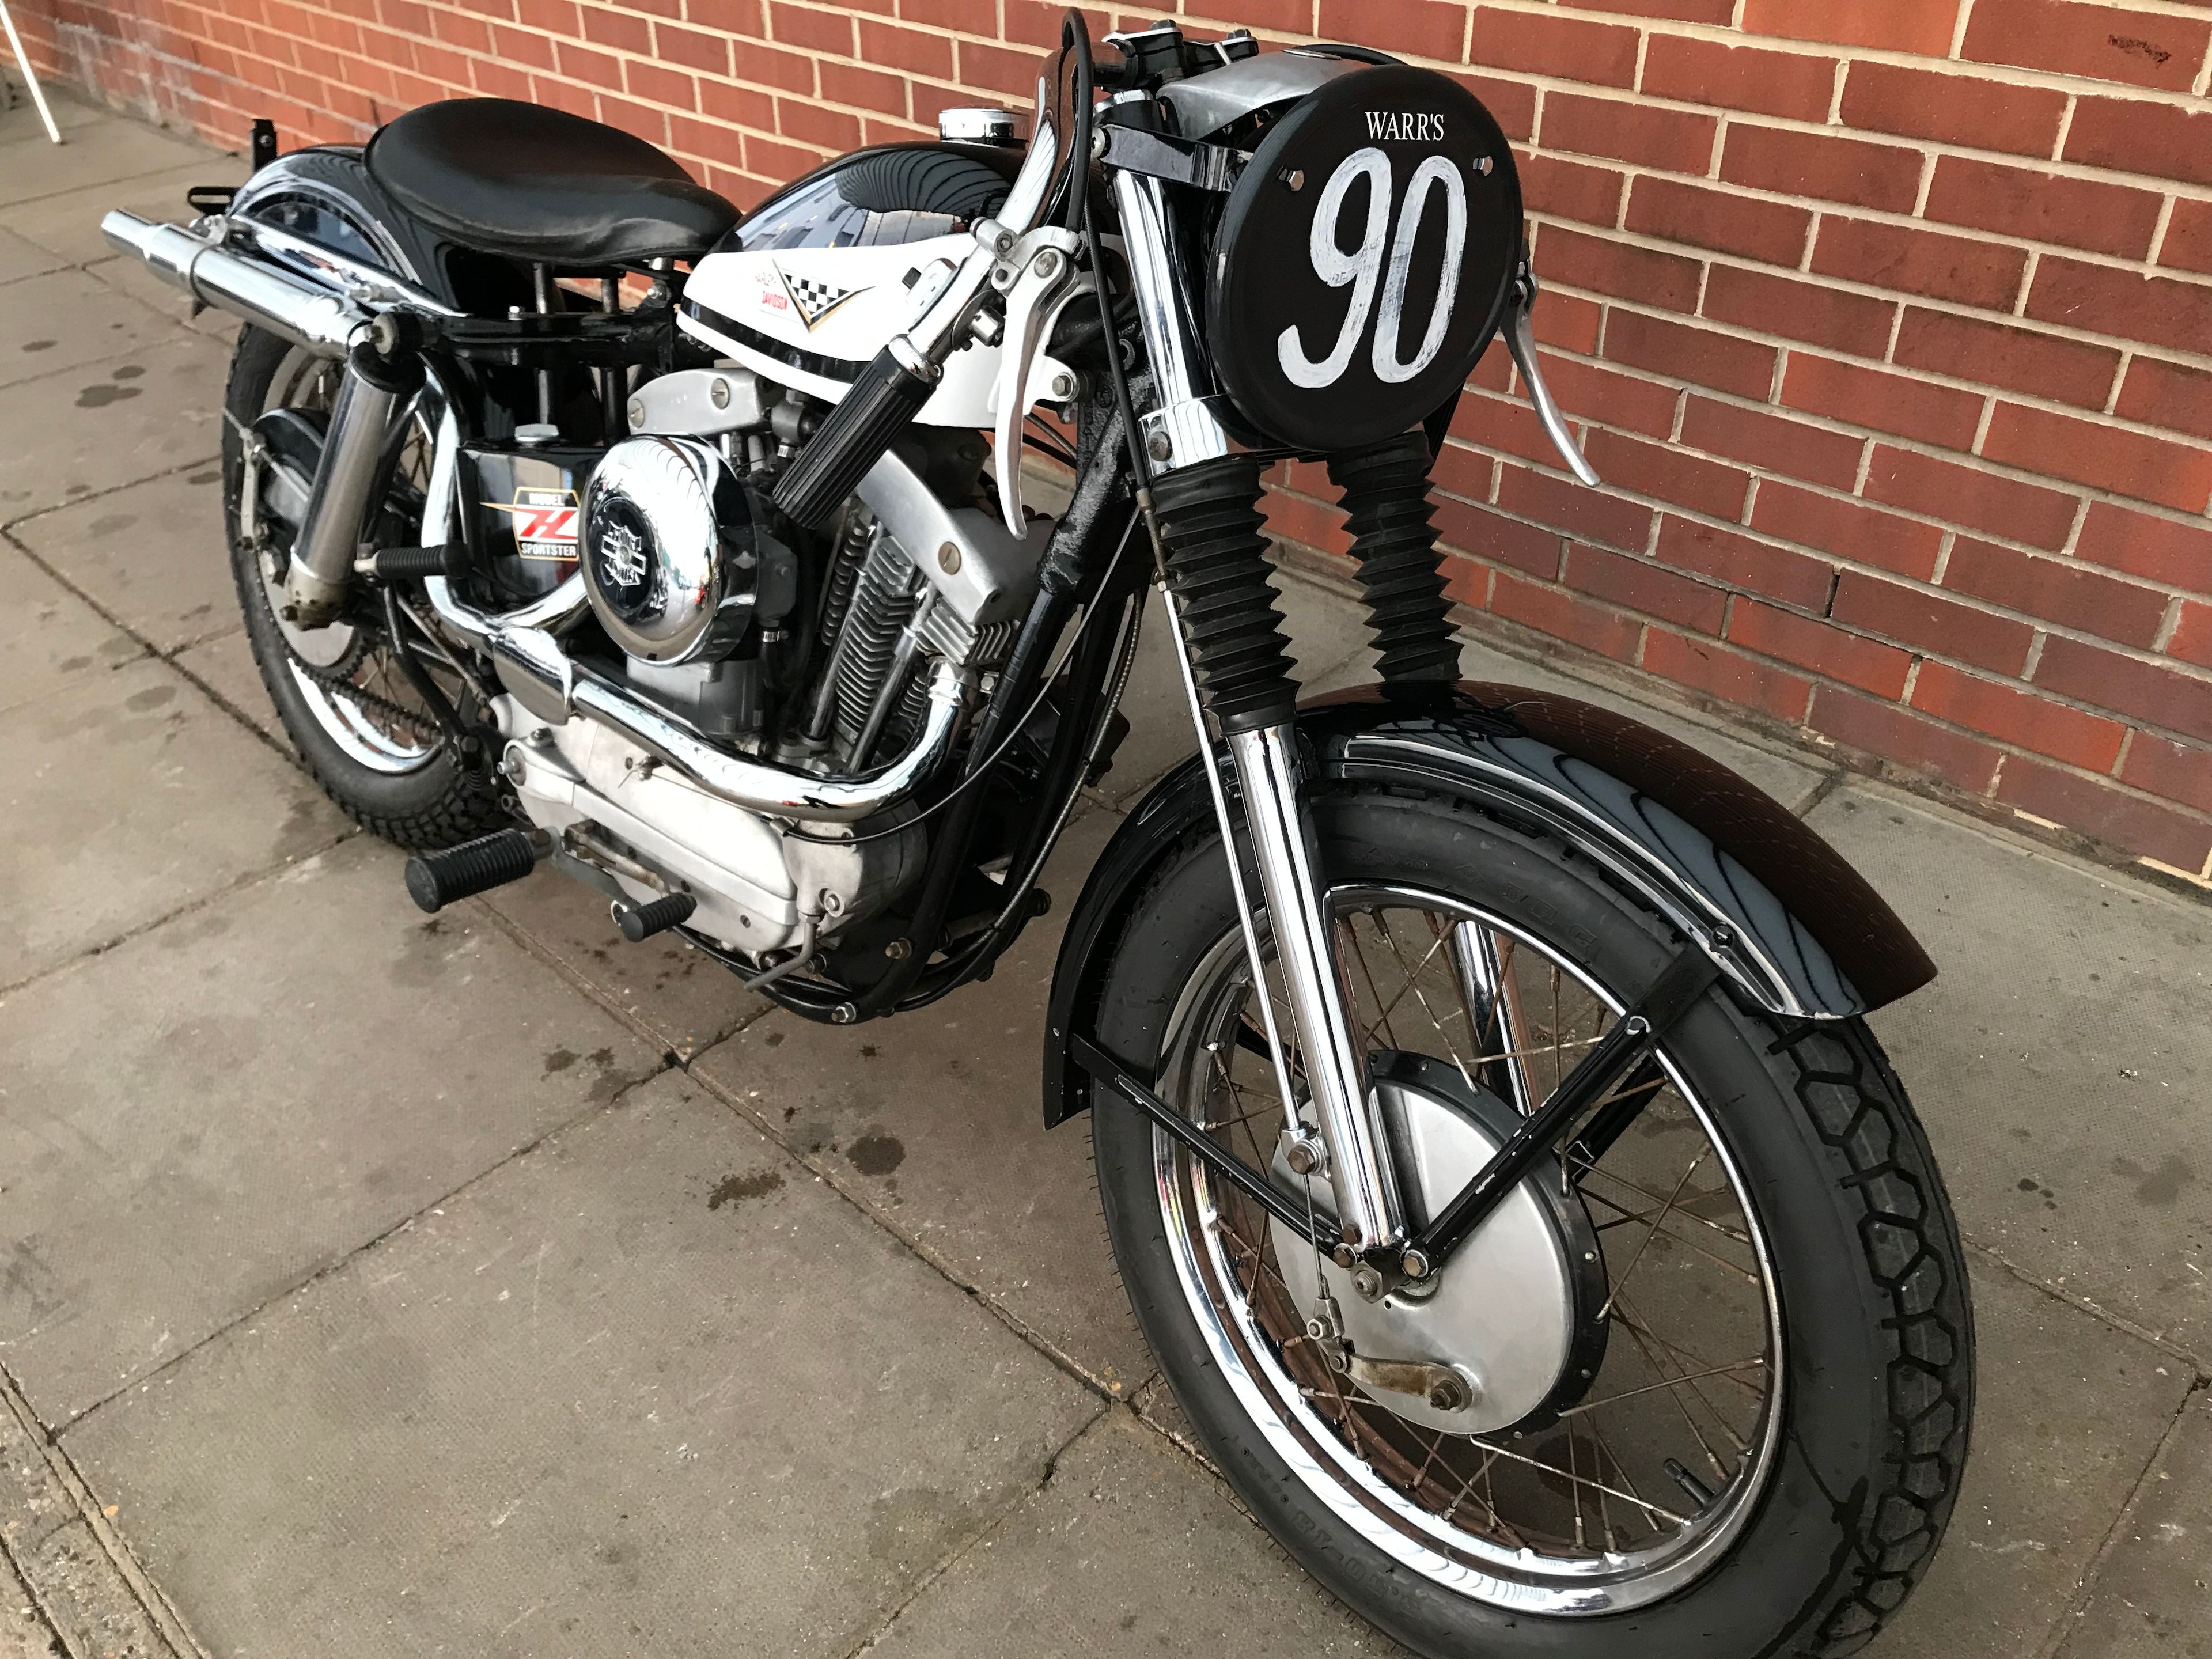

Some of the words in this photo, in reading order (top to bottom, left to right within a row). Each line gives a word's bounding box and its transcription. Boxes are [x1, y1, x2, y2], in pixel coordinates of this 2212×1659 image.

[1364, 111, 1444, 141] WARR'S
[1277, 146, 1467, 389] 90
[521, 543, 577, 556] SPORTSTER
